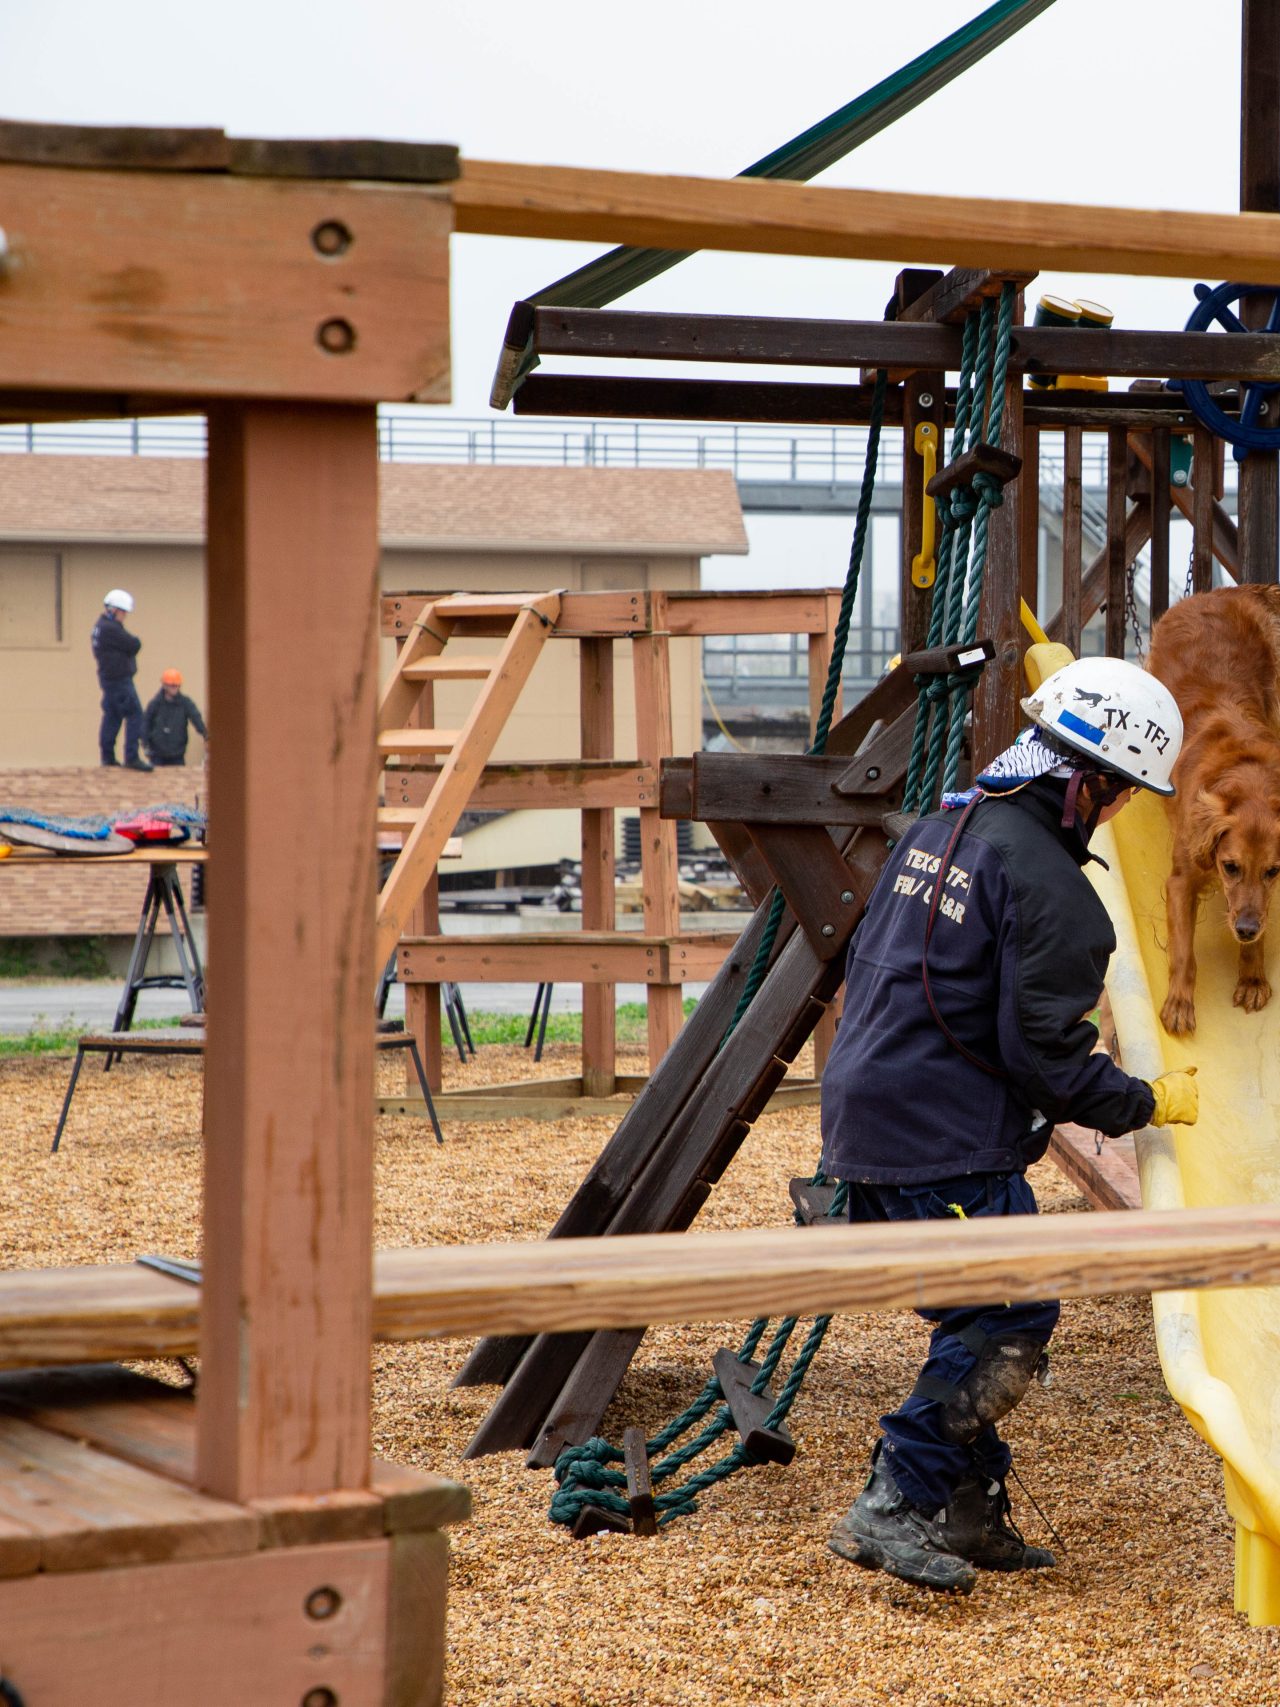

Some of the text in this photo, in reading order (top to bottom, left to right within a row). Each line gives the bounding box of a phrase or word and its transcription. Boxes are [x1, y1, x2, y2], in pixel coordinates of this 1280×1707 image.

[1104, 708, 1131, 730] TX
[1144, 719, 1170, 755] TF1
[945, 865, 973, 896] TF-
